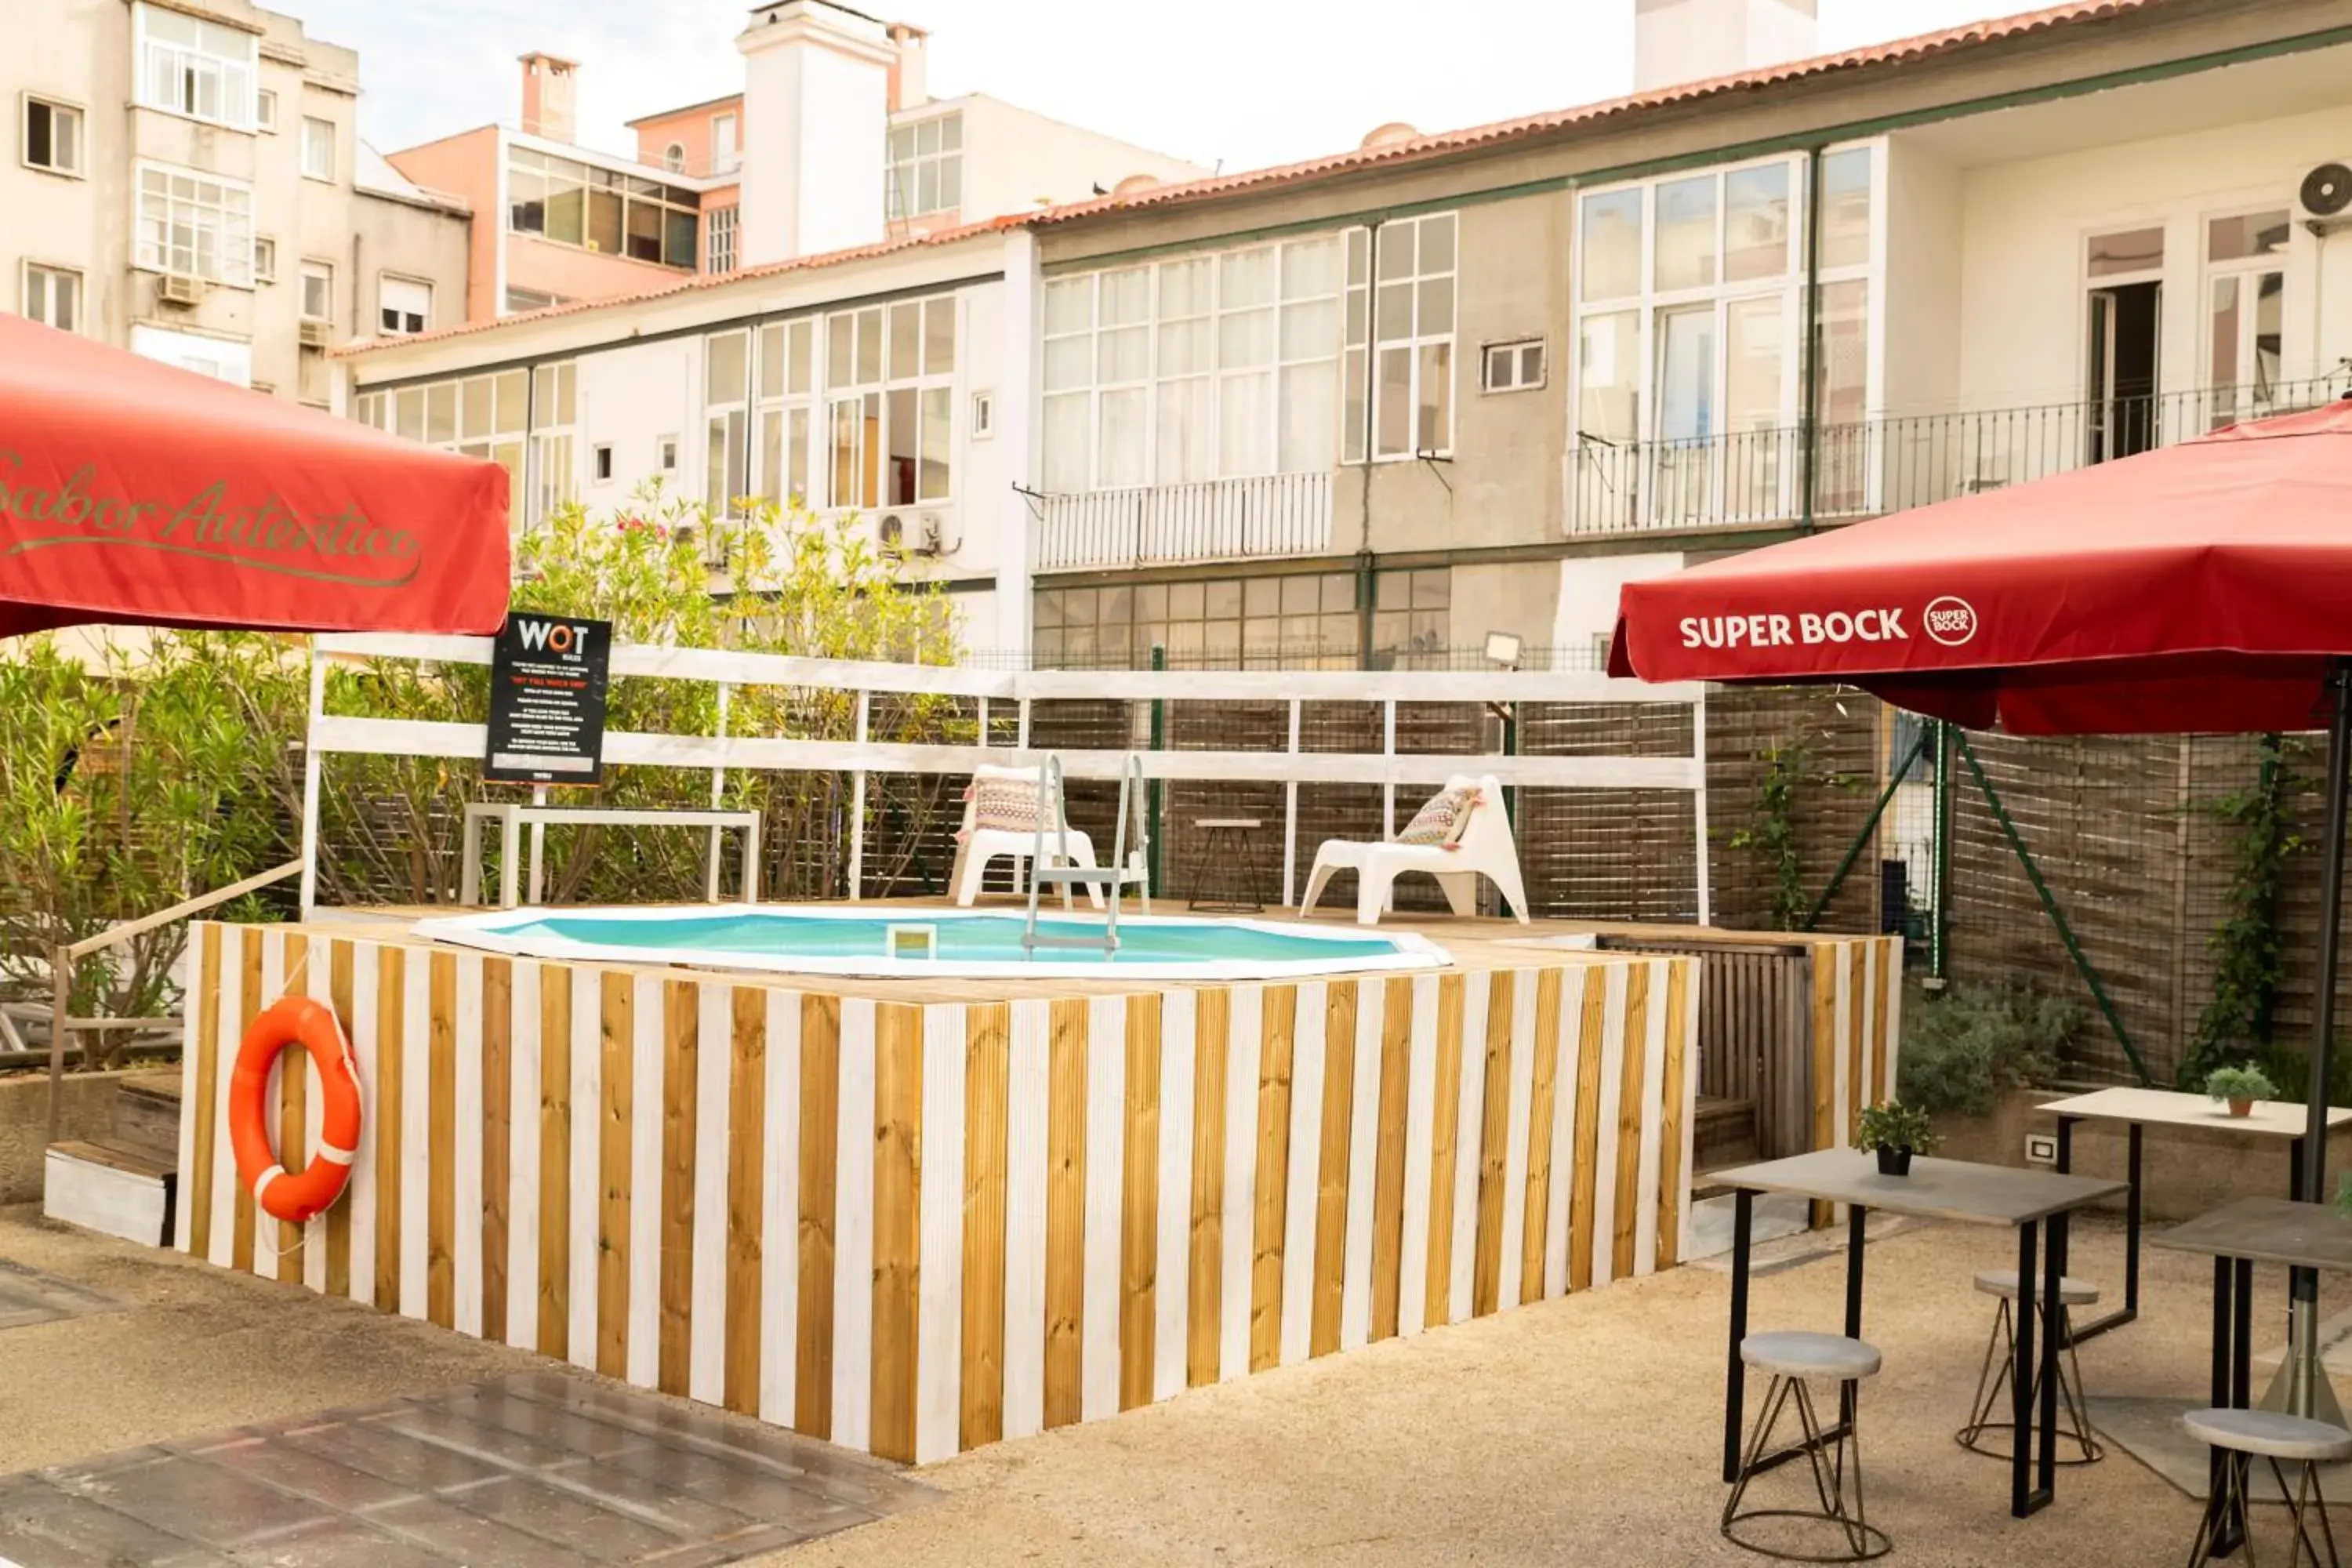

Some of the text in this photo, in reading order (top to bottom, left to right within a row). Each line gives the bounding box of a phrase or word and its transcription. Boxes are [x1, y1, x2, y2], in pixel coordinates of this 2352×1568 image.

[1929, 609, 1969, 621] SUPER
[1933, 619, 1969, 632] BOCK
[517, 619, 589, 655] WOT
[1679, 608, 1908, 648] SUPER BOCK
